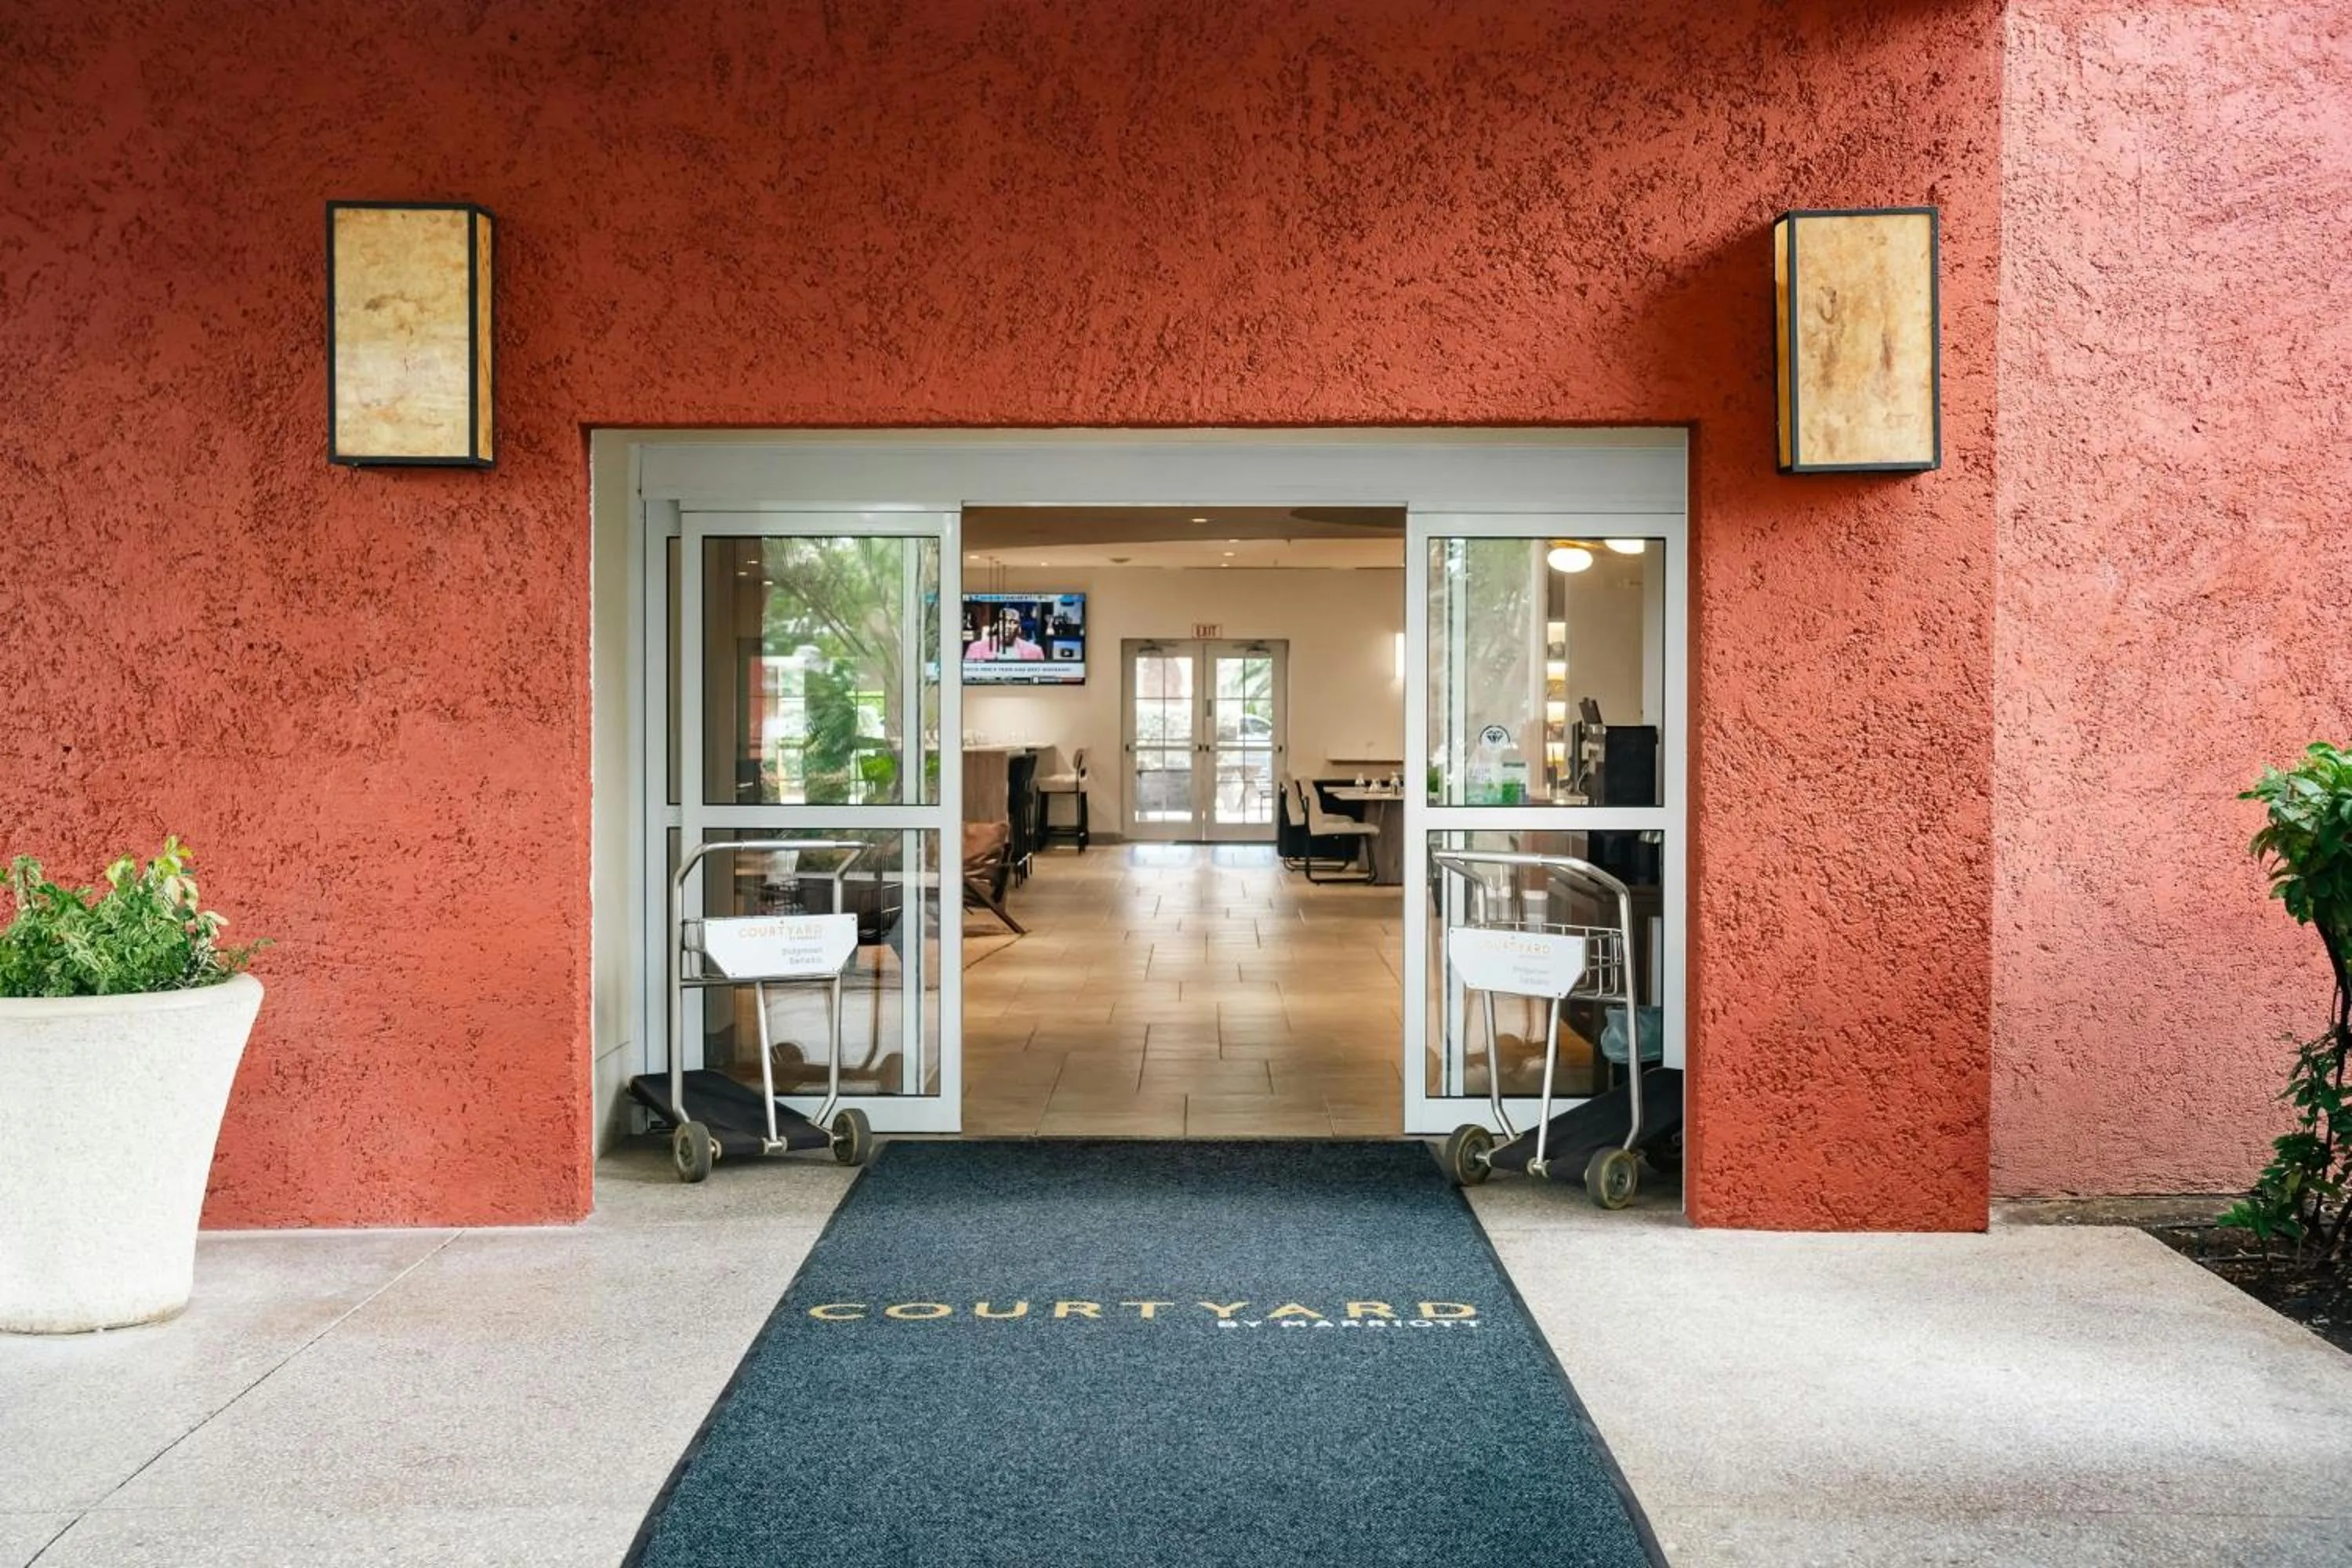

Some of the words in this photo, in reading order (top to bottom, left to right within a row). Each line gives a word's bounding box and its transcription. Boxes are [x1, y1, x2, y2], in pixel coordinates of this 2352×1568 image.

[1196, 625, 1217, 637] EXIT
[739, 925, 823, 938] COURTYARD
[808, 1301, 1478, 1319] COURTYARD
[1280, 1319, 1481, 1328] MARRIOTT
